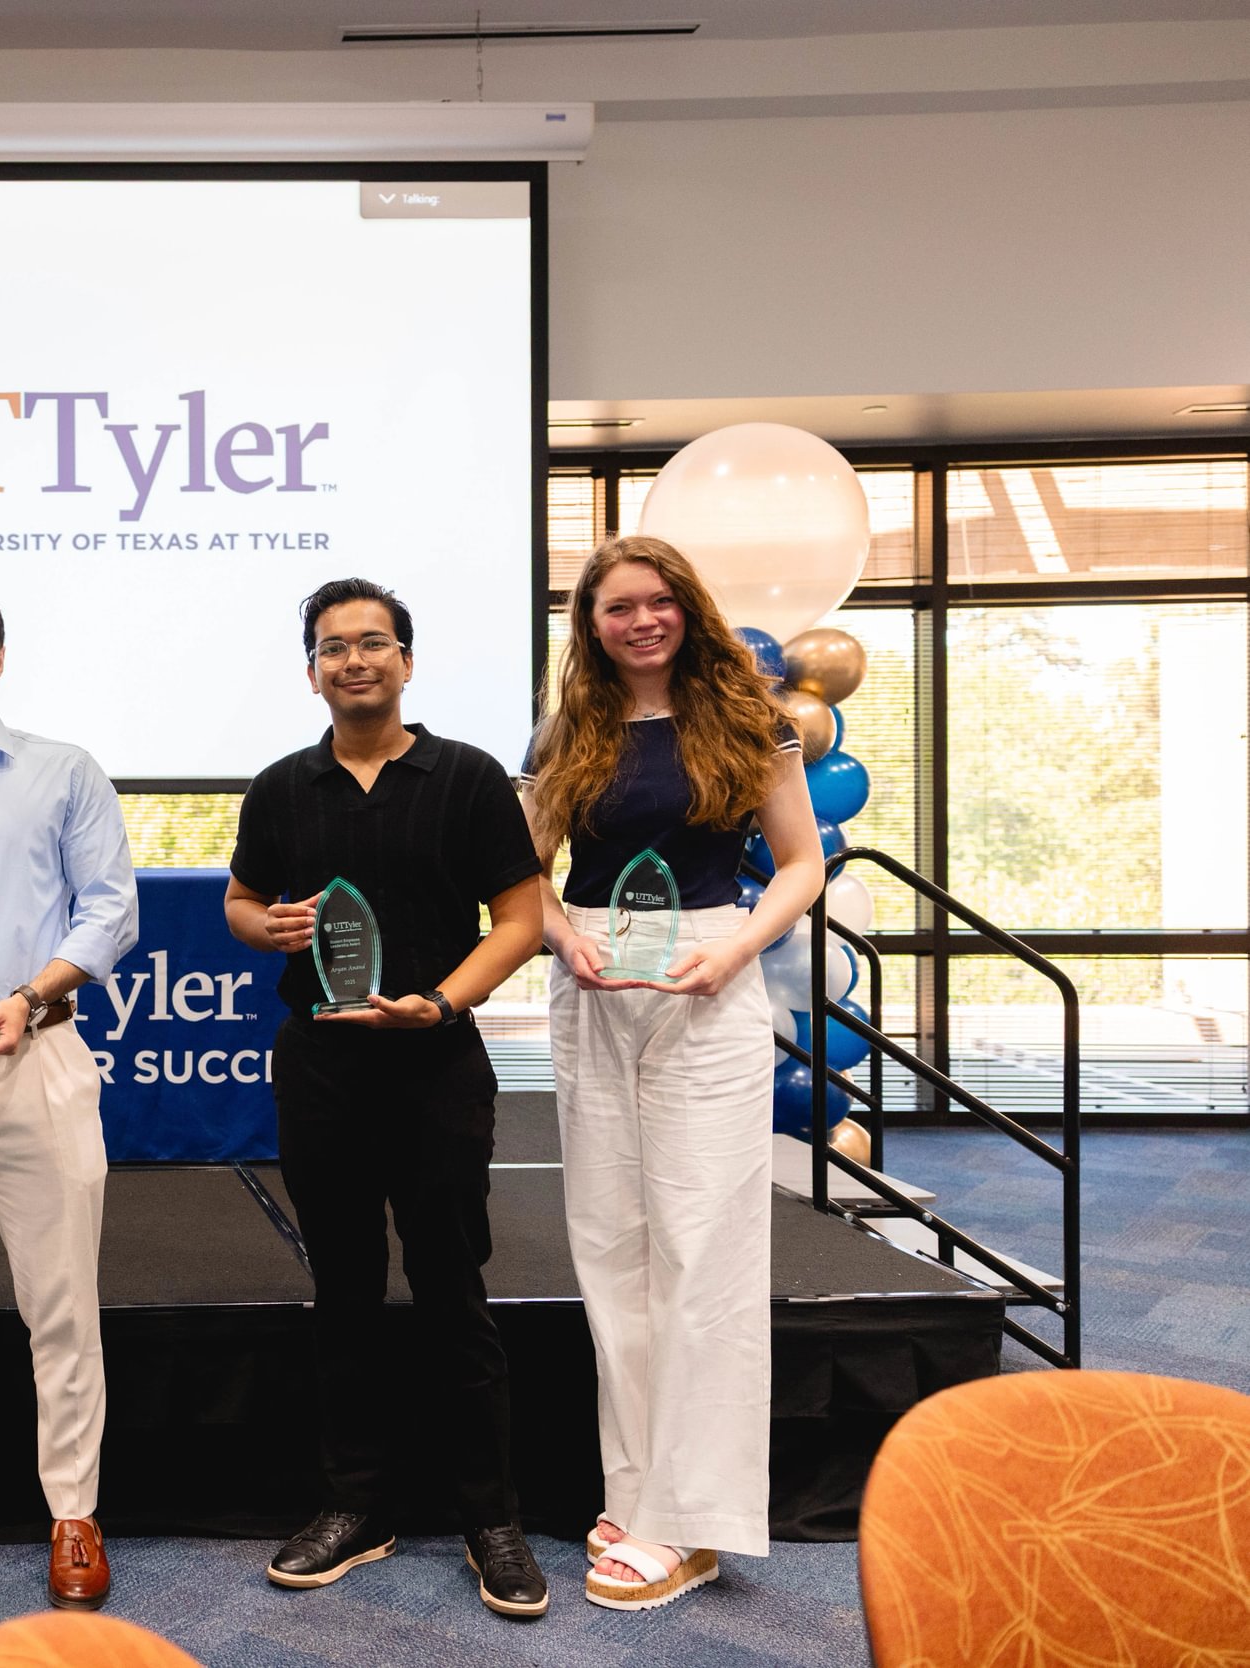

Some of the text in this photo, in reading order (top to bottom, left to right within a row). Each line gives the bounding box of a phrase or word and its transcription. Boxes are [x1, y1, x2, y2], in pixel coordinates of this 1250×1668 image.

[72, 533, 106, 551] OF
[115, 533, 198, 551] TEXAS
[208, 533, 239, 550] AT
[248, 532, 329, 550] TYLER
[74, 949, 253, 1041] yler
[133, 1049, 273, 1084] SUCC
